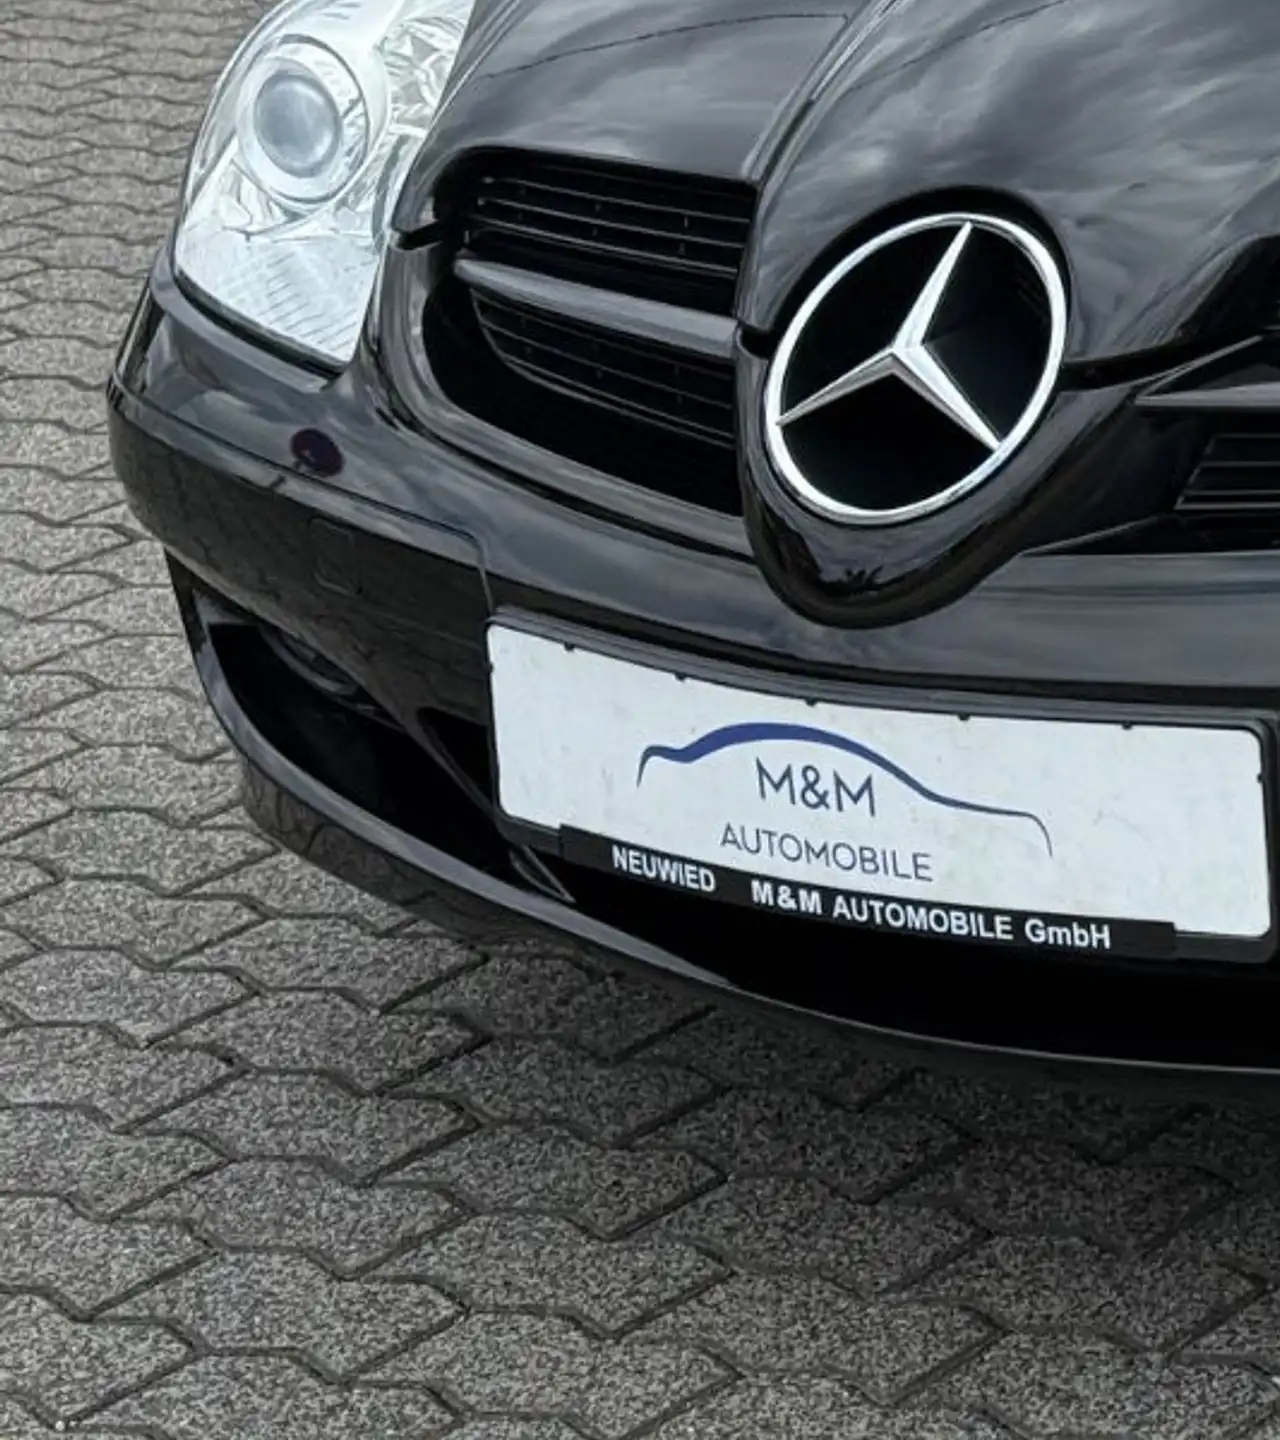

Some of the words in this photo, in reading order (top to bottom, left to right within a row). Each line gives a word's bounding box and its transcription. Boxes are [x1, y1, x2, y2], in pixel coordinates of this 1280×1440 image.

[756, 757, 876, 817] M&M
[721, 823, 932, 881] AUTOMOBILE
[612, 846, 715, 893] NEUWIED
[751, 880, 822, 916] M&M
[833, 895, 1012, 940] AUTOMOBILE
[1024, 918, 1110, 950] GmbH
